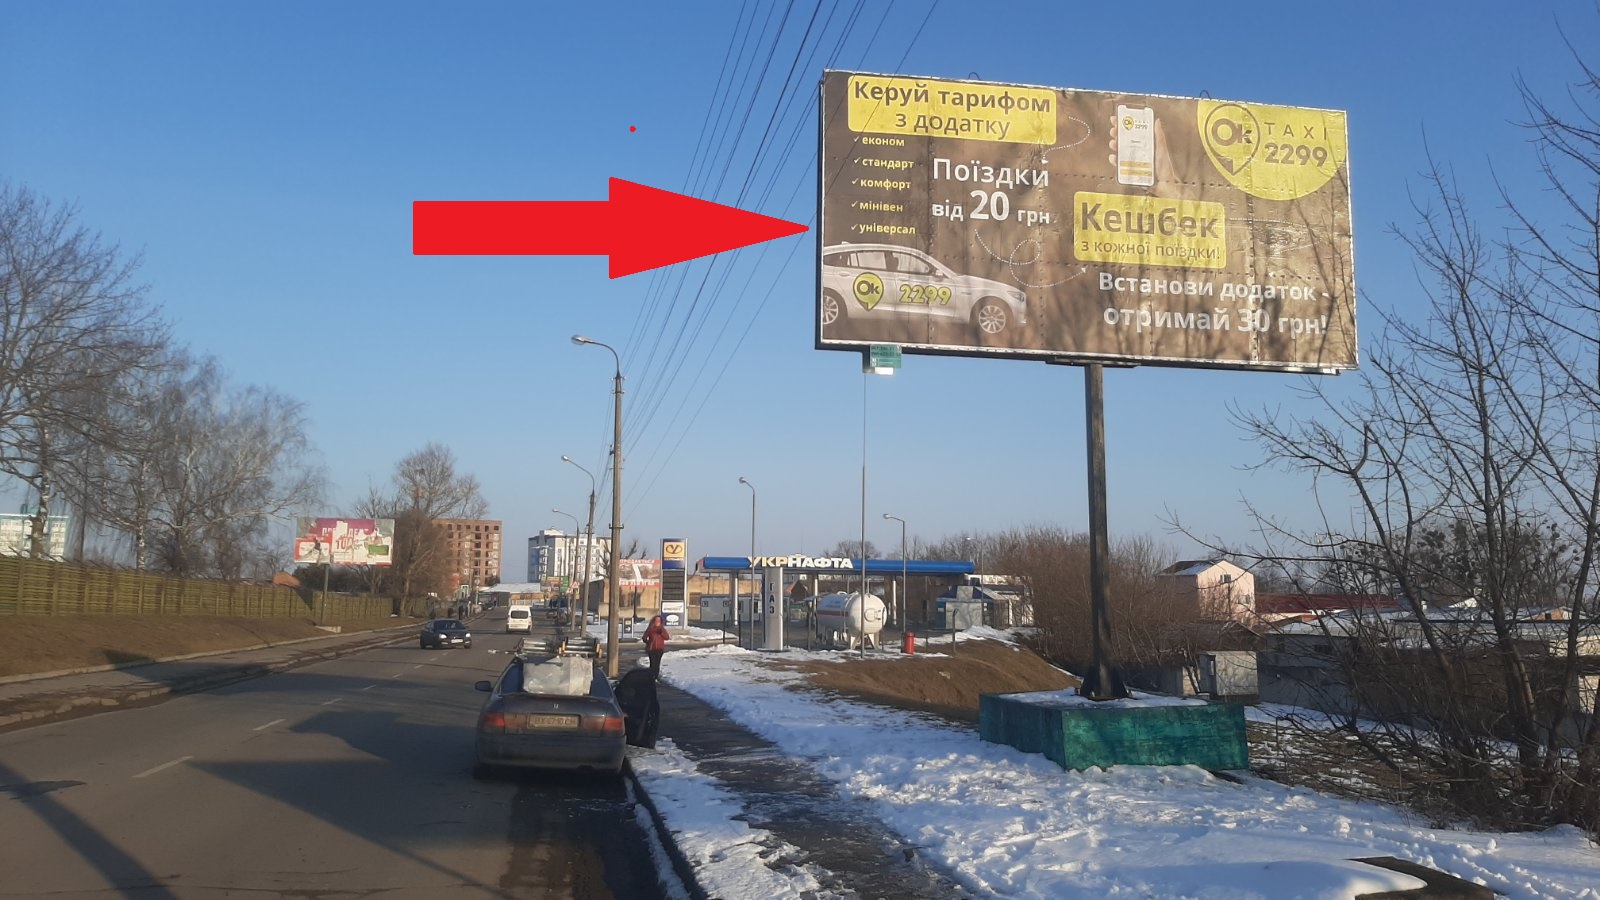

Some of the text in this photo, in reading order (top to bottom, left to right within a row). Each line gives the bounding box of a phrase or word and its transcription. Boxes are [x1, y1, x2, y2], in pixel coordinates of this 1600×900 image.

[855, 81, 1050, 114] Керуй тарифом
[914, 114, 1010, 140] додатку
[1264, 122, 1328, 141] TAXI
[862, 137, 905, 147] економ
[862, 159, 914, 170] стандарт
[1264, 143, 1328, 167] 2299
[860, 178, 911, 191] комфорт
[933, 158, 1049, 189] Поїздки
[859, 201, 903, 212] мінівен
[932, 199, 964, 221] від
[969, 190, 1010, 221] 20
[858, 223, 916, 235] універсал
[1081, 202, 1220, 239] Кешбек
[1094, 241, 1150, 255] кожної
[1155, 242, 1221, 261] поїздки!
[899, 284, 952, 306] 2299
[1099, 272, 1213, 297] Встанови
[1219, 281, 1317, 303] додаток
[1103, 306, 1328, 340] отримай 30 грн!
[748, 555, 853, 569] УКРНАФТА
